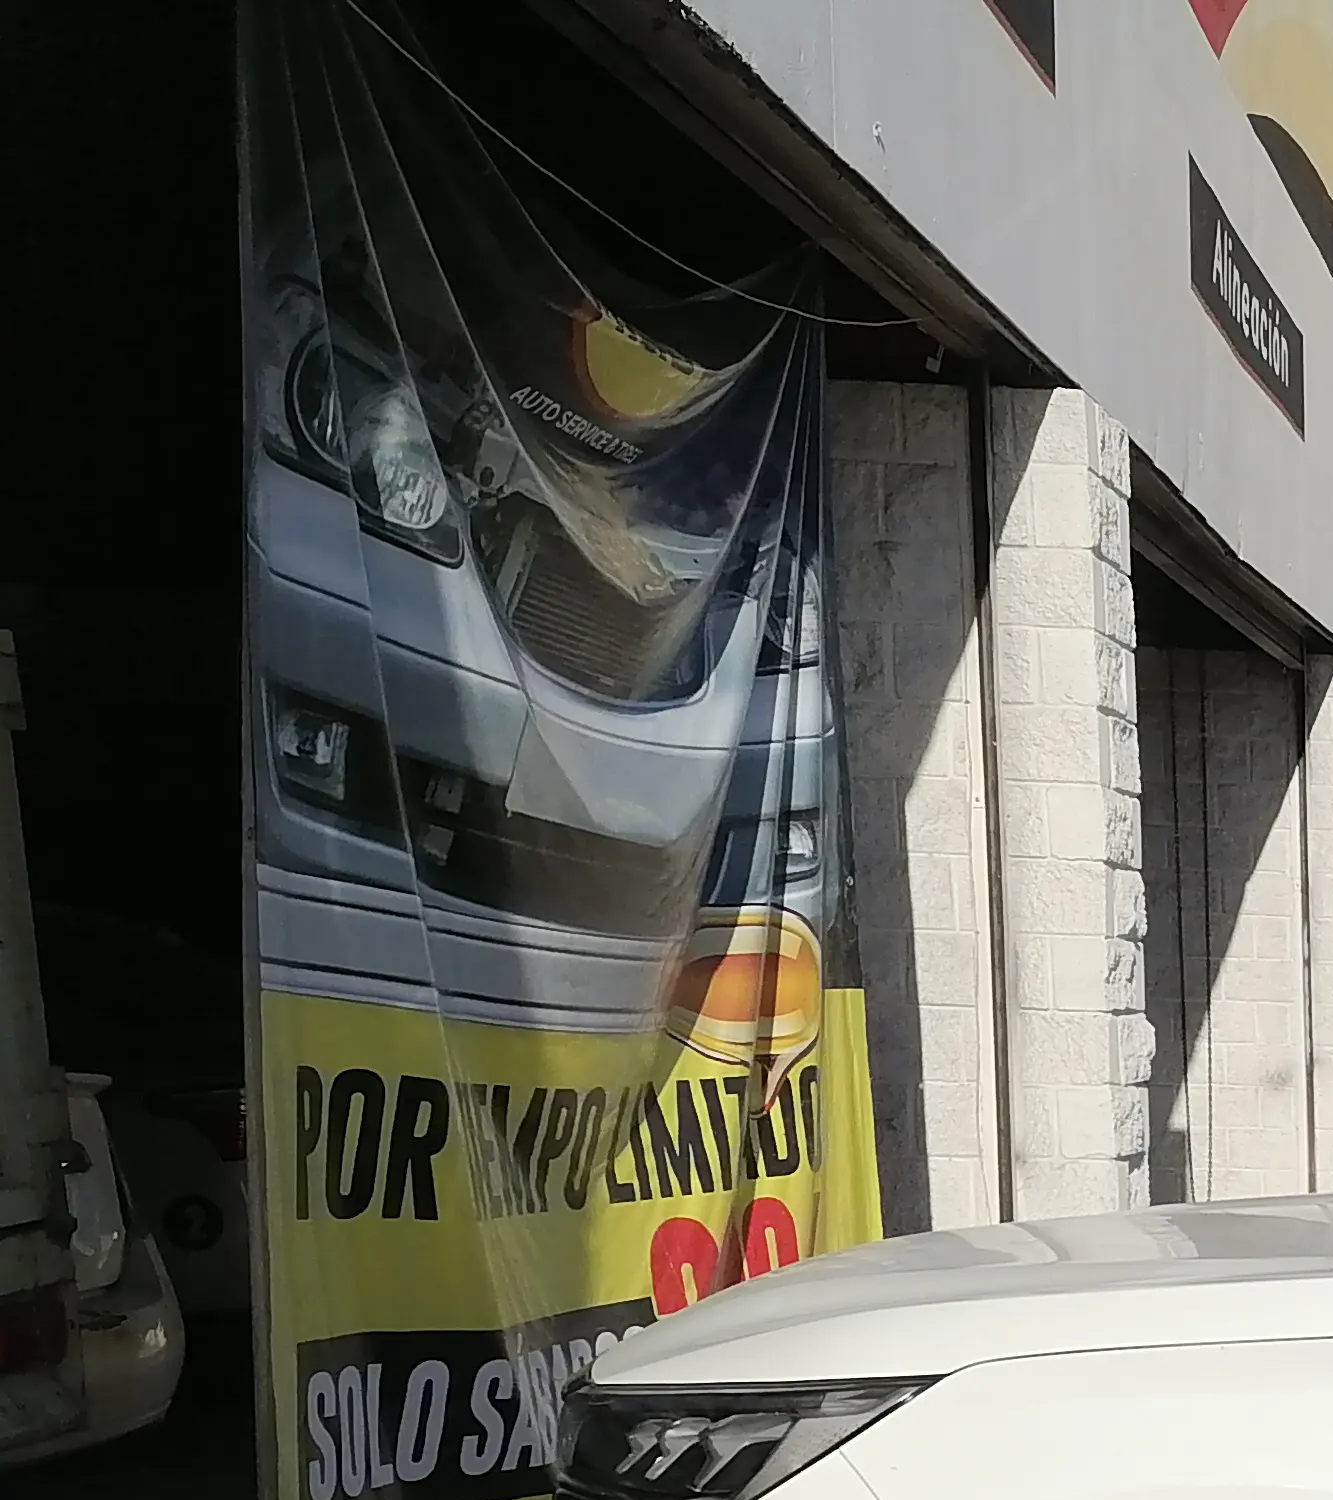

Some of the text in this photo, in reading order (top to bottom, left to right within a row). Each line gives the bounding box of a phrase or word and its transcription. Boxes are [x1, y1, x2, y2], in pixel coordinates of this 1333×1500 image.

[1212, 218, 1290, 388] Alineación
[510, 386, 561, 421] AUTO
[555, 410, 614, 453] SERVICE
[296, 1065, 450, 1221] POR
